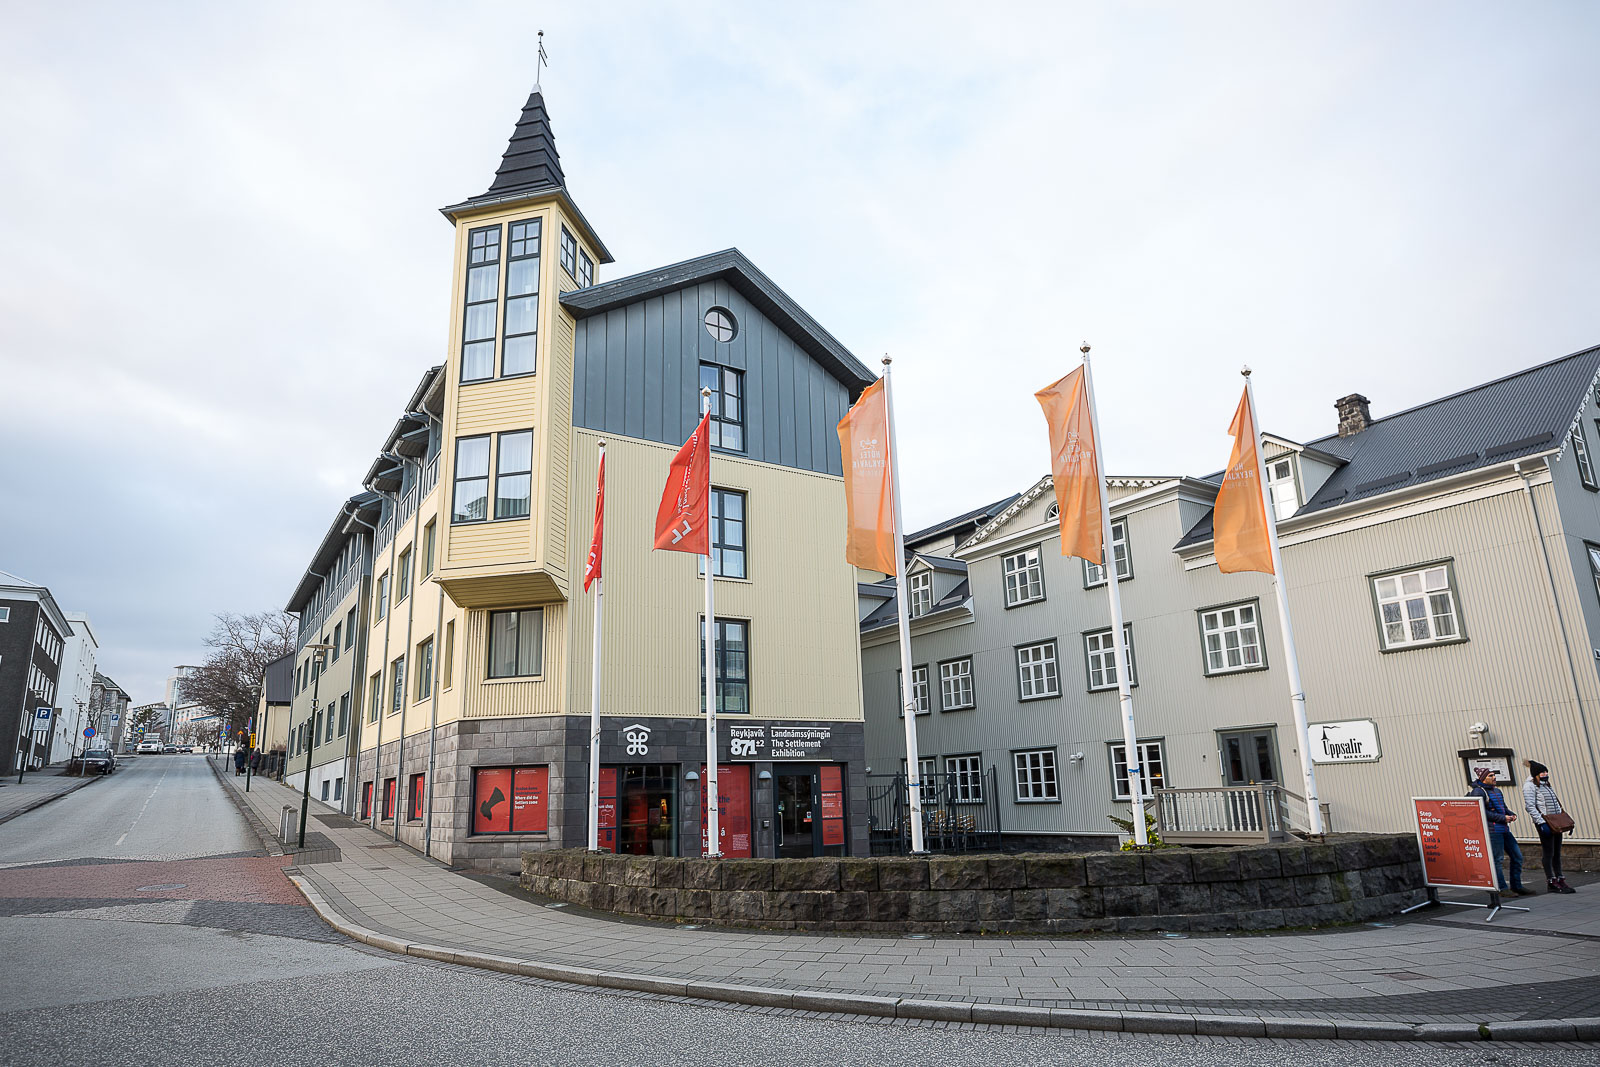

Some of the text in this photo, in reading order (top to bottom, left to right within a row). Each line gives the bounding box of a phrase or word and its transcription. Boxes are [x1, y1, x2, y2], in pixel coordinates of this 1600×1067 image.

[730, 729, 765, 739] Reykjavík
[771, 730, 831, 739] Landnámssýningin
[771, 739, 821, 748] The Settlement
[771, 748, 806, 757] Exhibition
[1322, 738, 1363, 759] Uppsalir
[1421, 823, 1439, 831] Viking
